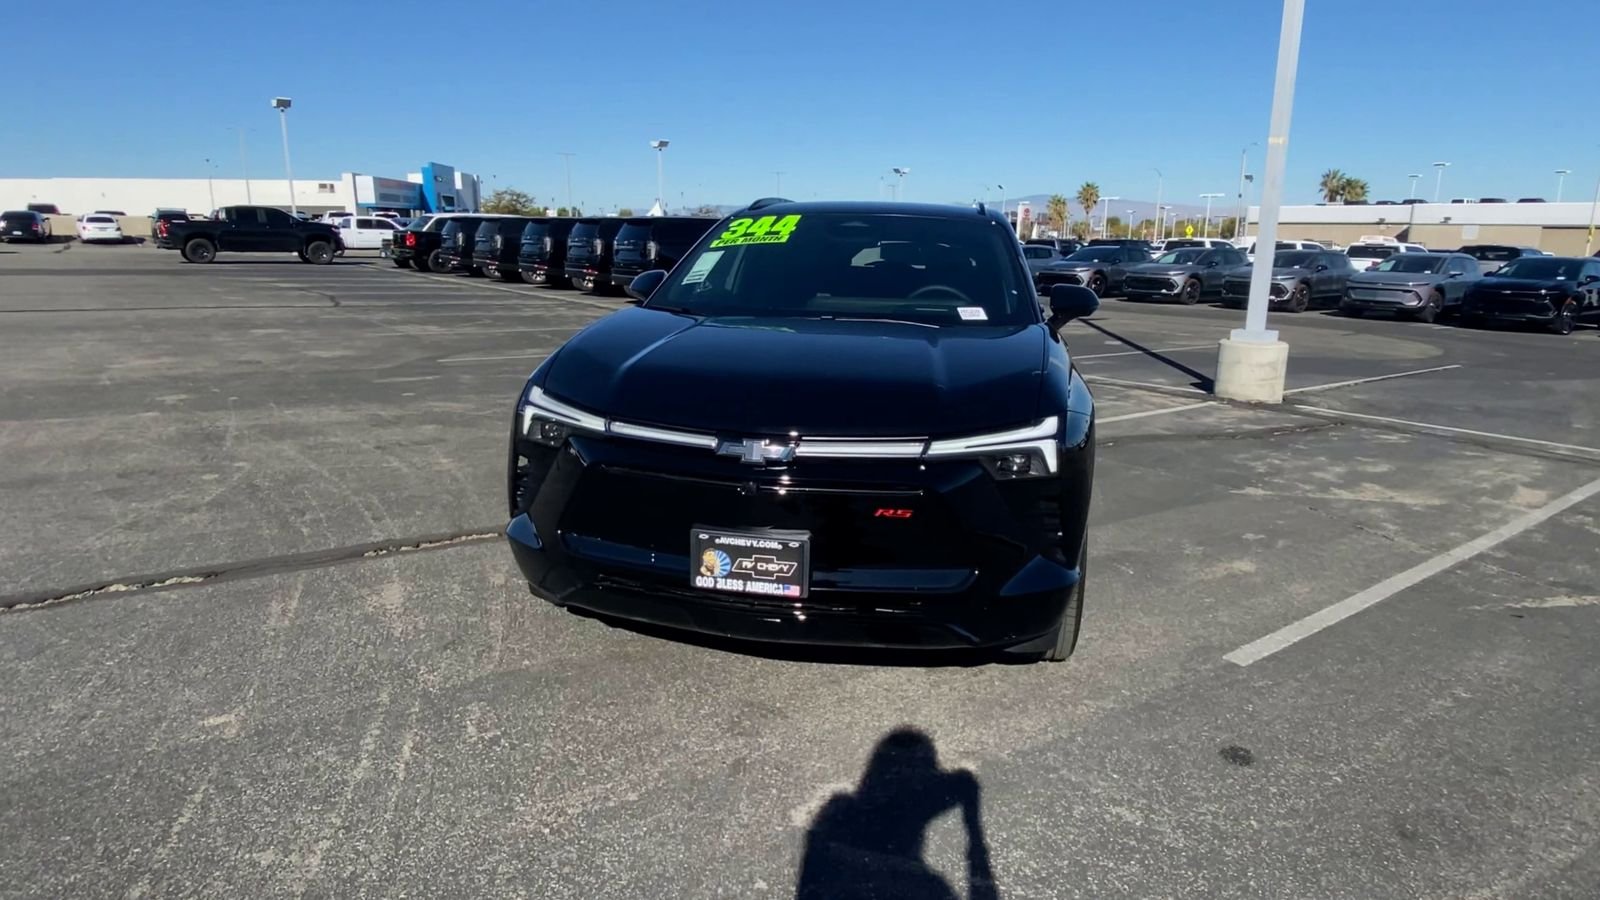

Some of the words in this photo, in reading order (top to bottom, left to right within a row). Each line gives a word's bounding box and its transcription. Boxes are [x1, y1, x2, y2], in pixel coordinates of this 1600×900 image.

[720, 214, 802, 239] 344
[716, 238, 738, 246] PER
[741, 235, 783, 244] MONTH
[874, 508, 913, 518] RS
[695, 576, 715, 588] GOD
[716, 578, 744, 591] BLESS
[745, 581, 784, 595] AMERICA
